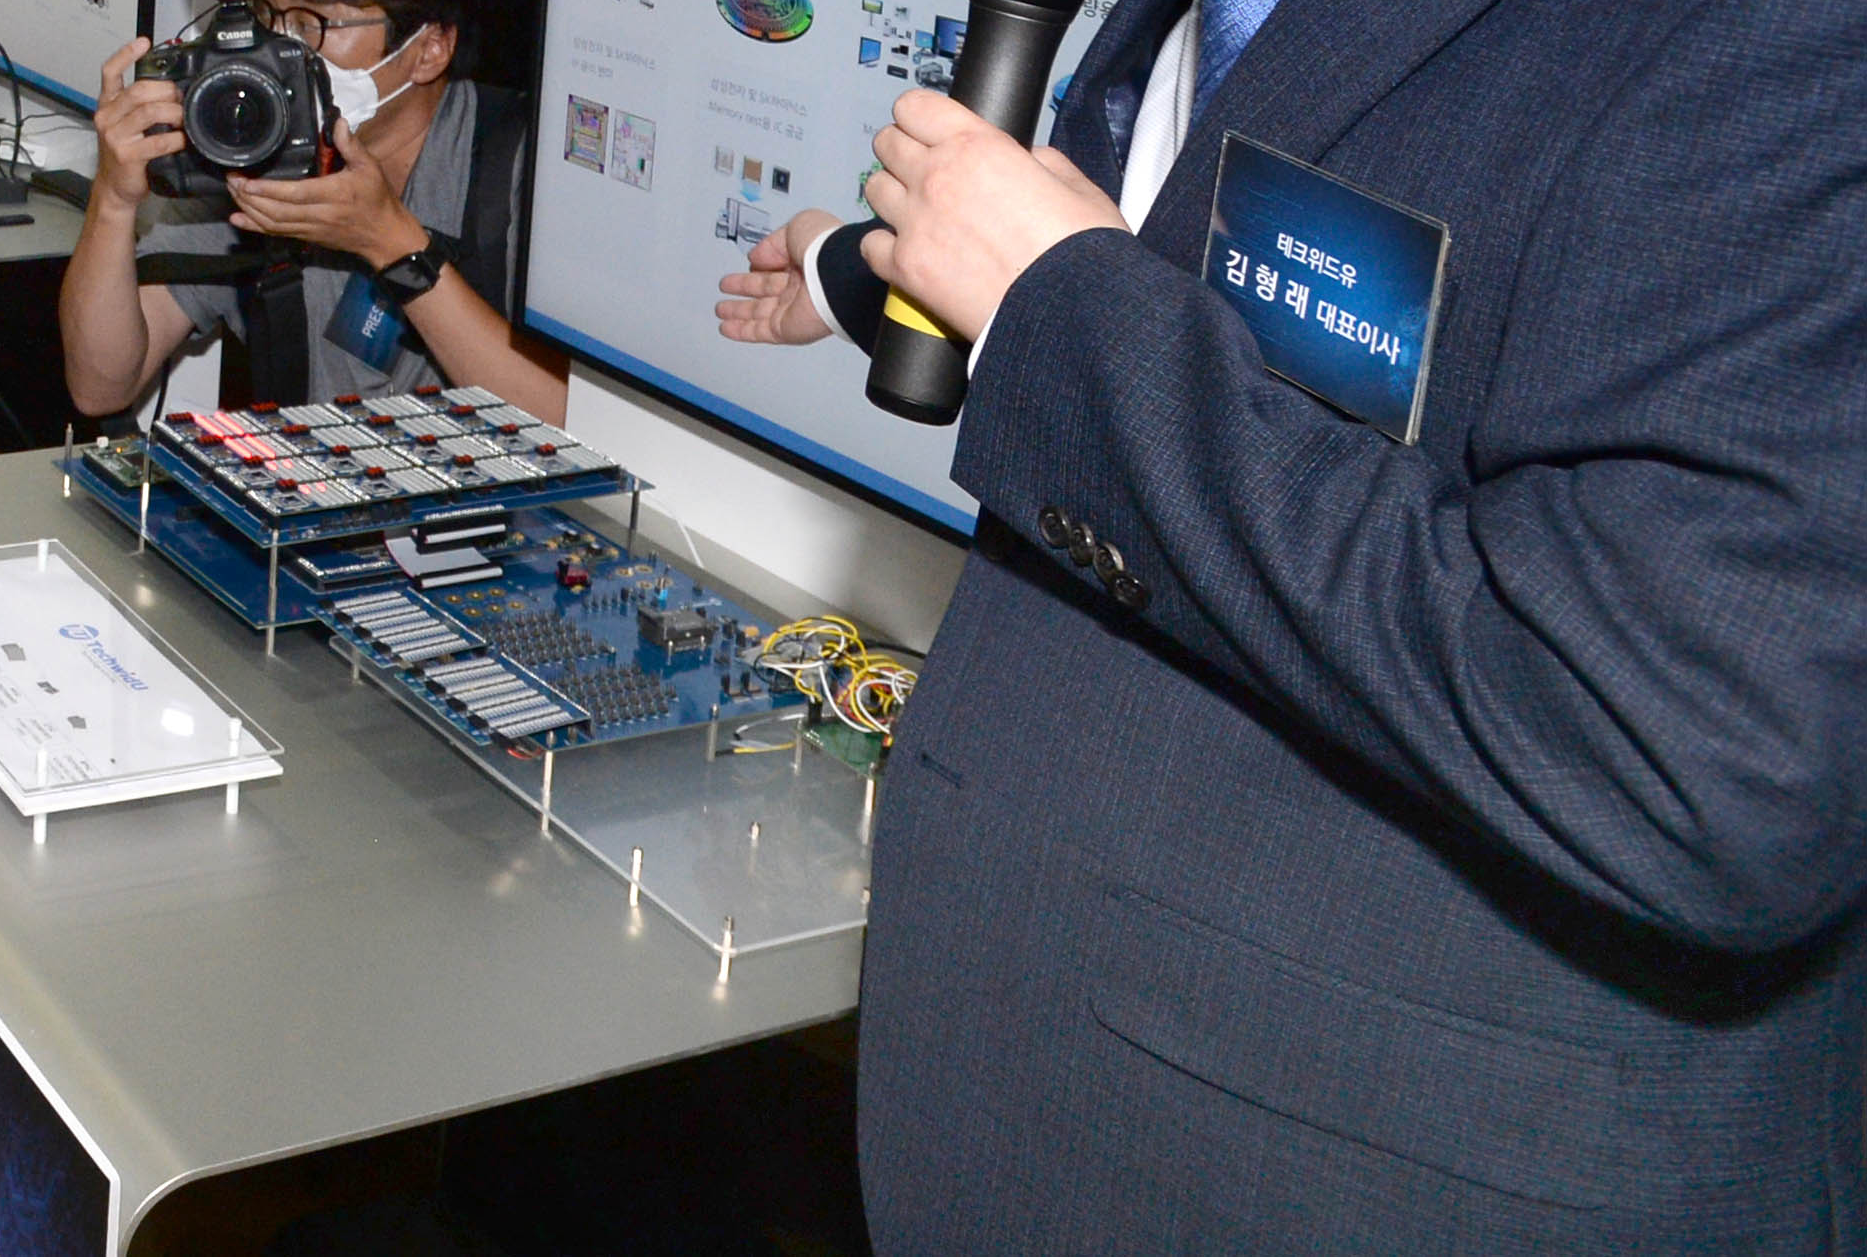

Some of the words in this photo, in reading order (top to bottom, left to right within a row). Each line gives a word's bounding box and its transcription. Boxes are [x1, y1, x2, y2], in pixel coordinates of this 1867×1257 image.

[216, 29, 253, 41] Canon
[1276, 232, 1358, 289] 테크위드유
[361, 304, 385, 339] PRES
[1226, 249, 1248, 287] 김
[1255, 263, 1279, 302] 형
[1285, 279, 1310, 319] 래
[1315, 299, 1401, 365] 대표이사
[87, 640, 149, 690] TechwidU
